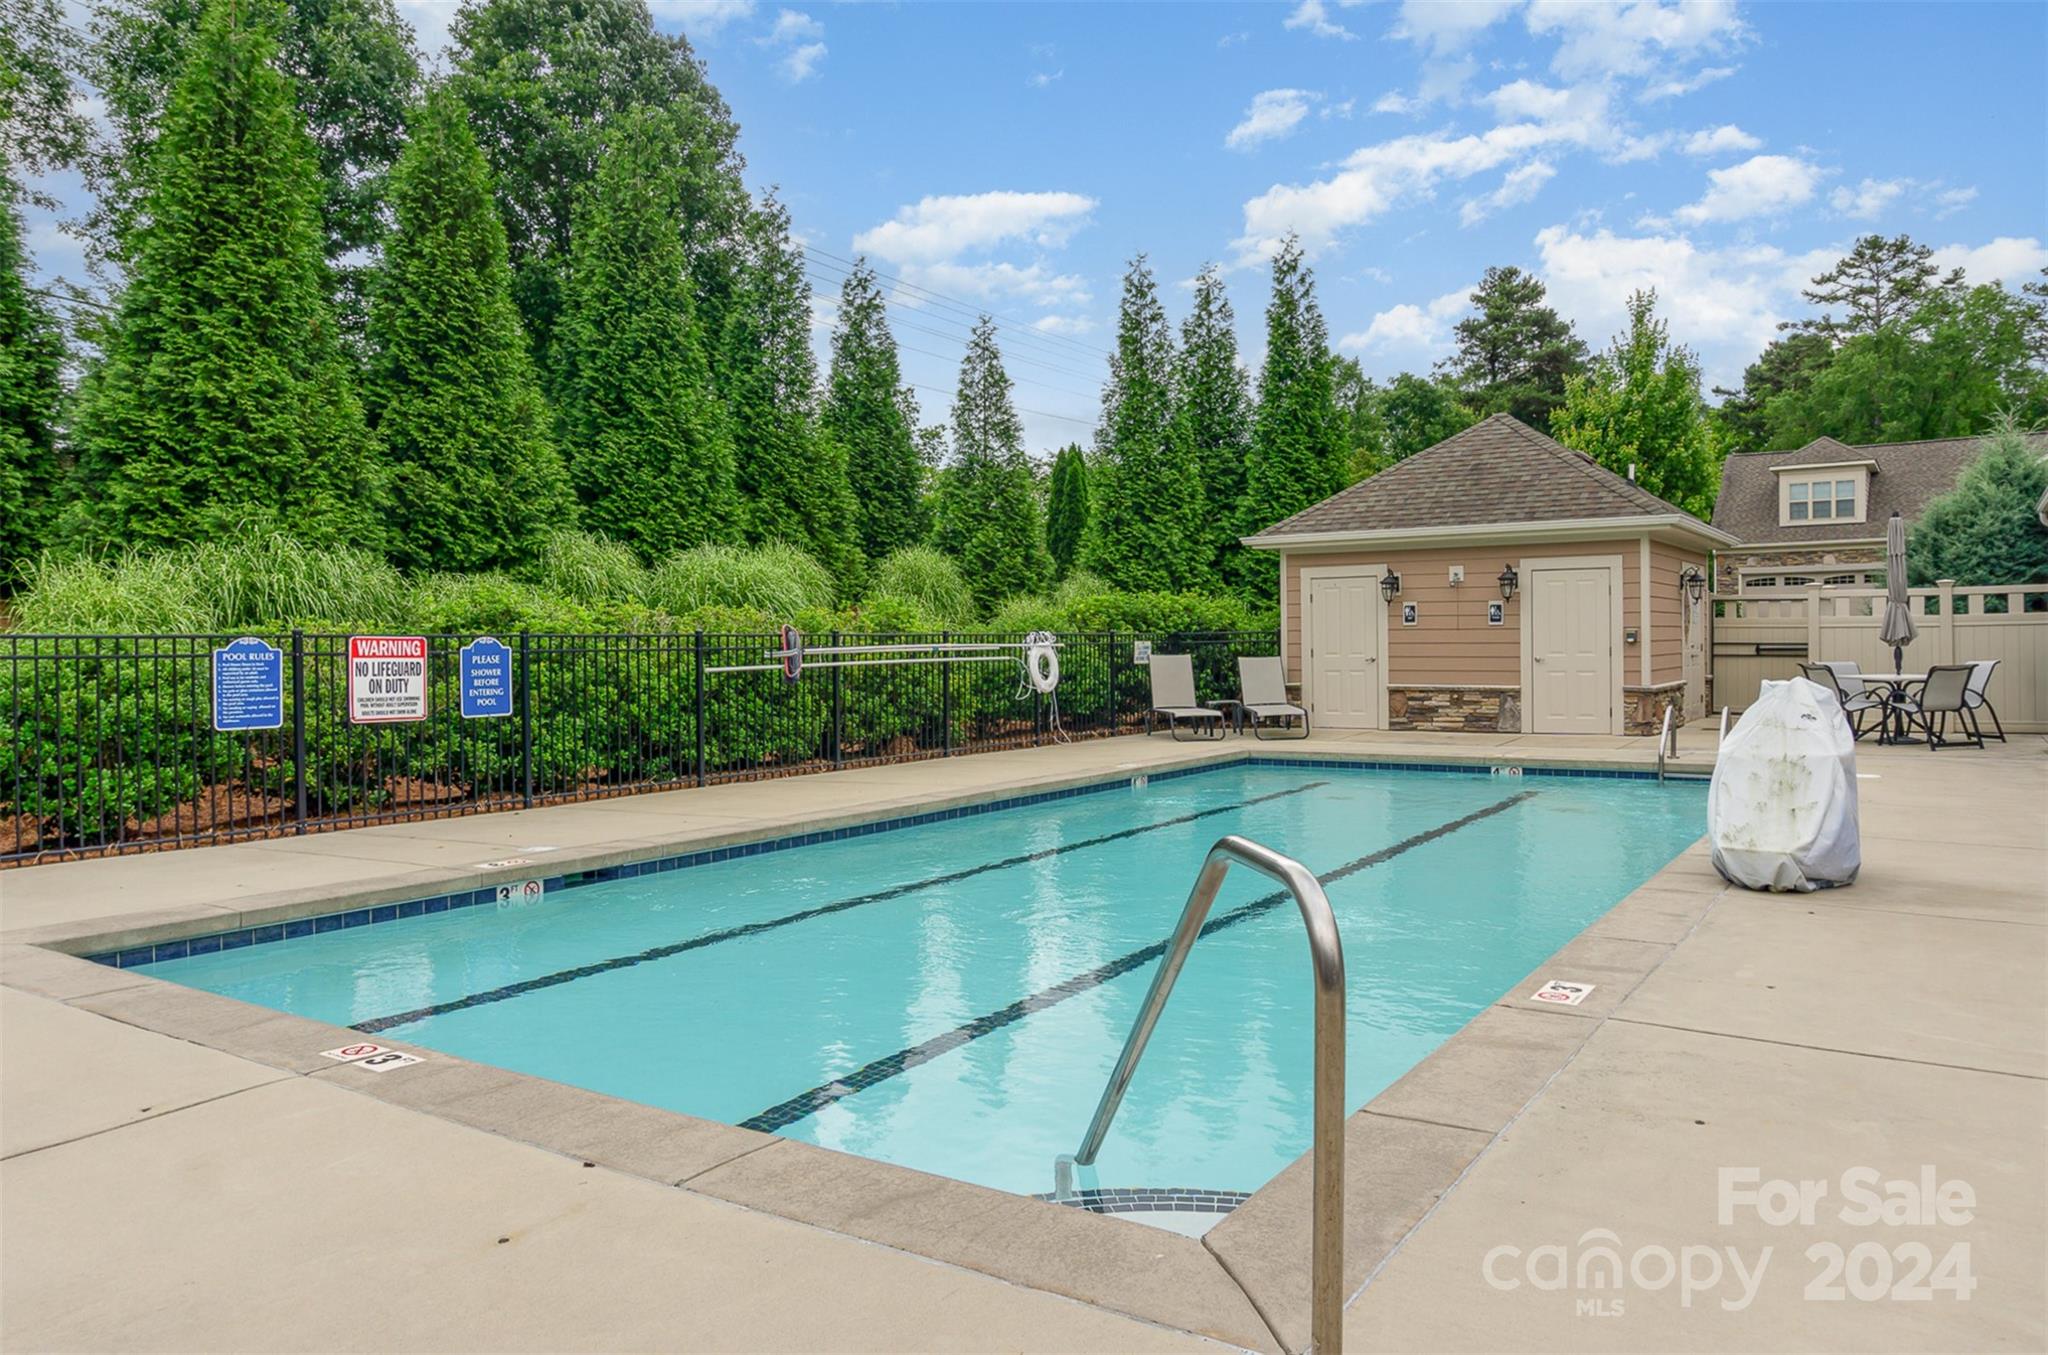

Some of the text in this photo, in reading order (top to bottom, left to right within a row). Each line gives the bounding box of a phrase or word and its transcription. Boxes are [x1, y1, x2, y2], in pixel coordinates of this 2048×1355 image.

[356, 640, 421, 656] WARNING
[222, 652, 275, 661] POOL RULES
[472, 654, 500, 664] PLEASE
[355, 661, 422, 677] NO LIFEGUARD
[471, 668, 502, 677] SHOWER
[368, 678, 409, 694] ON DUTY
[474, 678, 499, 686] BEFORE
[469, 688, 504, 697] ENTERING
[500, 886, 510, 900] 3
[1550, 985, 1583, 993] 3
[364, 1053, 403, 1065] 3
